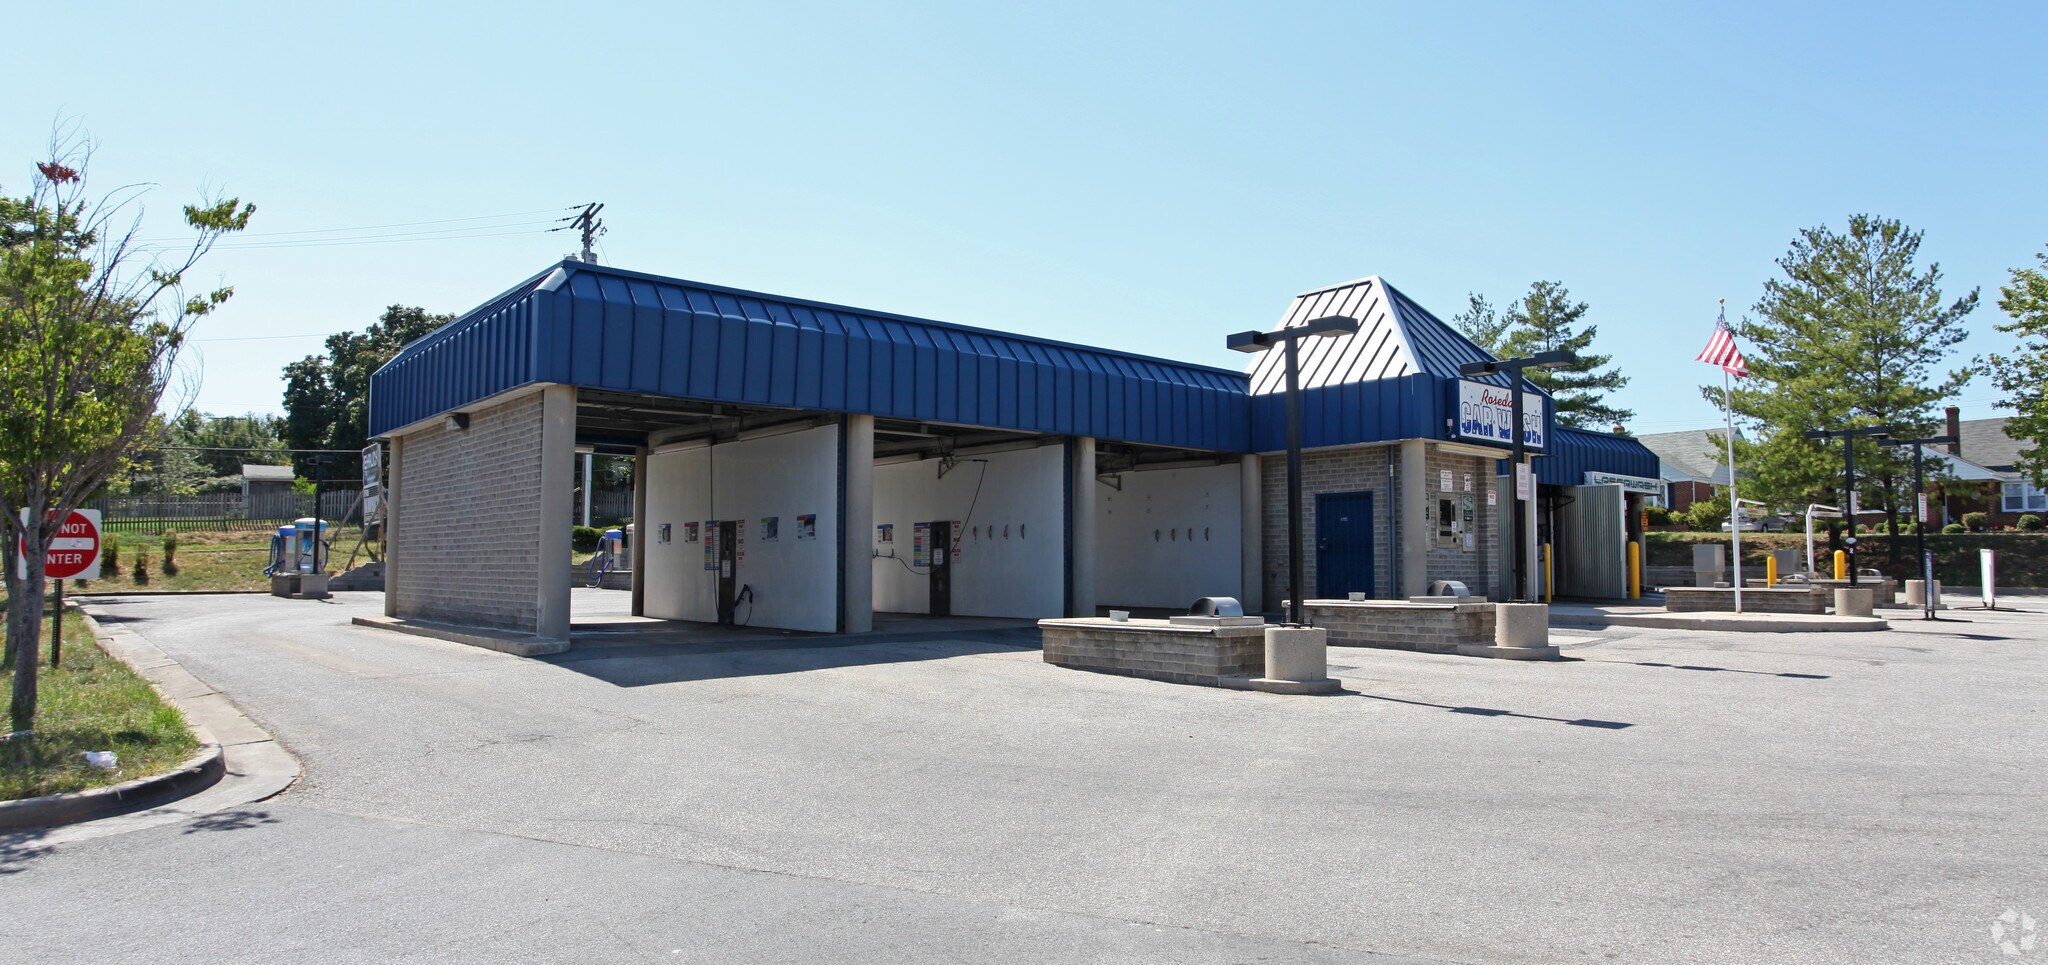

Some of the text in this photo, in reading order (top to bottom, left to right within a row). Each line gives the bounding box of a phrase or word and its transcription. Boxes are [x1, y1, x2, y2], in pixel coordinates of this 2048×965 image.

[1482, 389, 1513, 408] Roseda
[1461, 401, 1542, 444] CAR WSH
[61, 523, 87, 534] NOT
[47, 553, 82, 564] NTER
